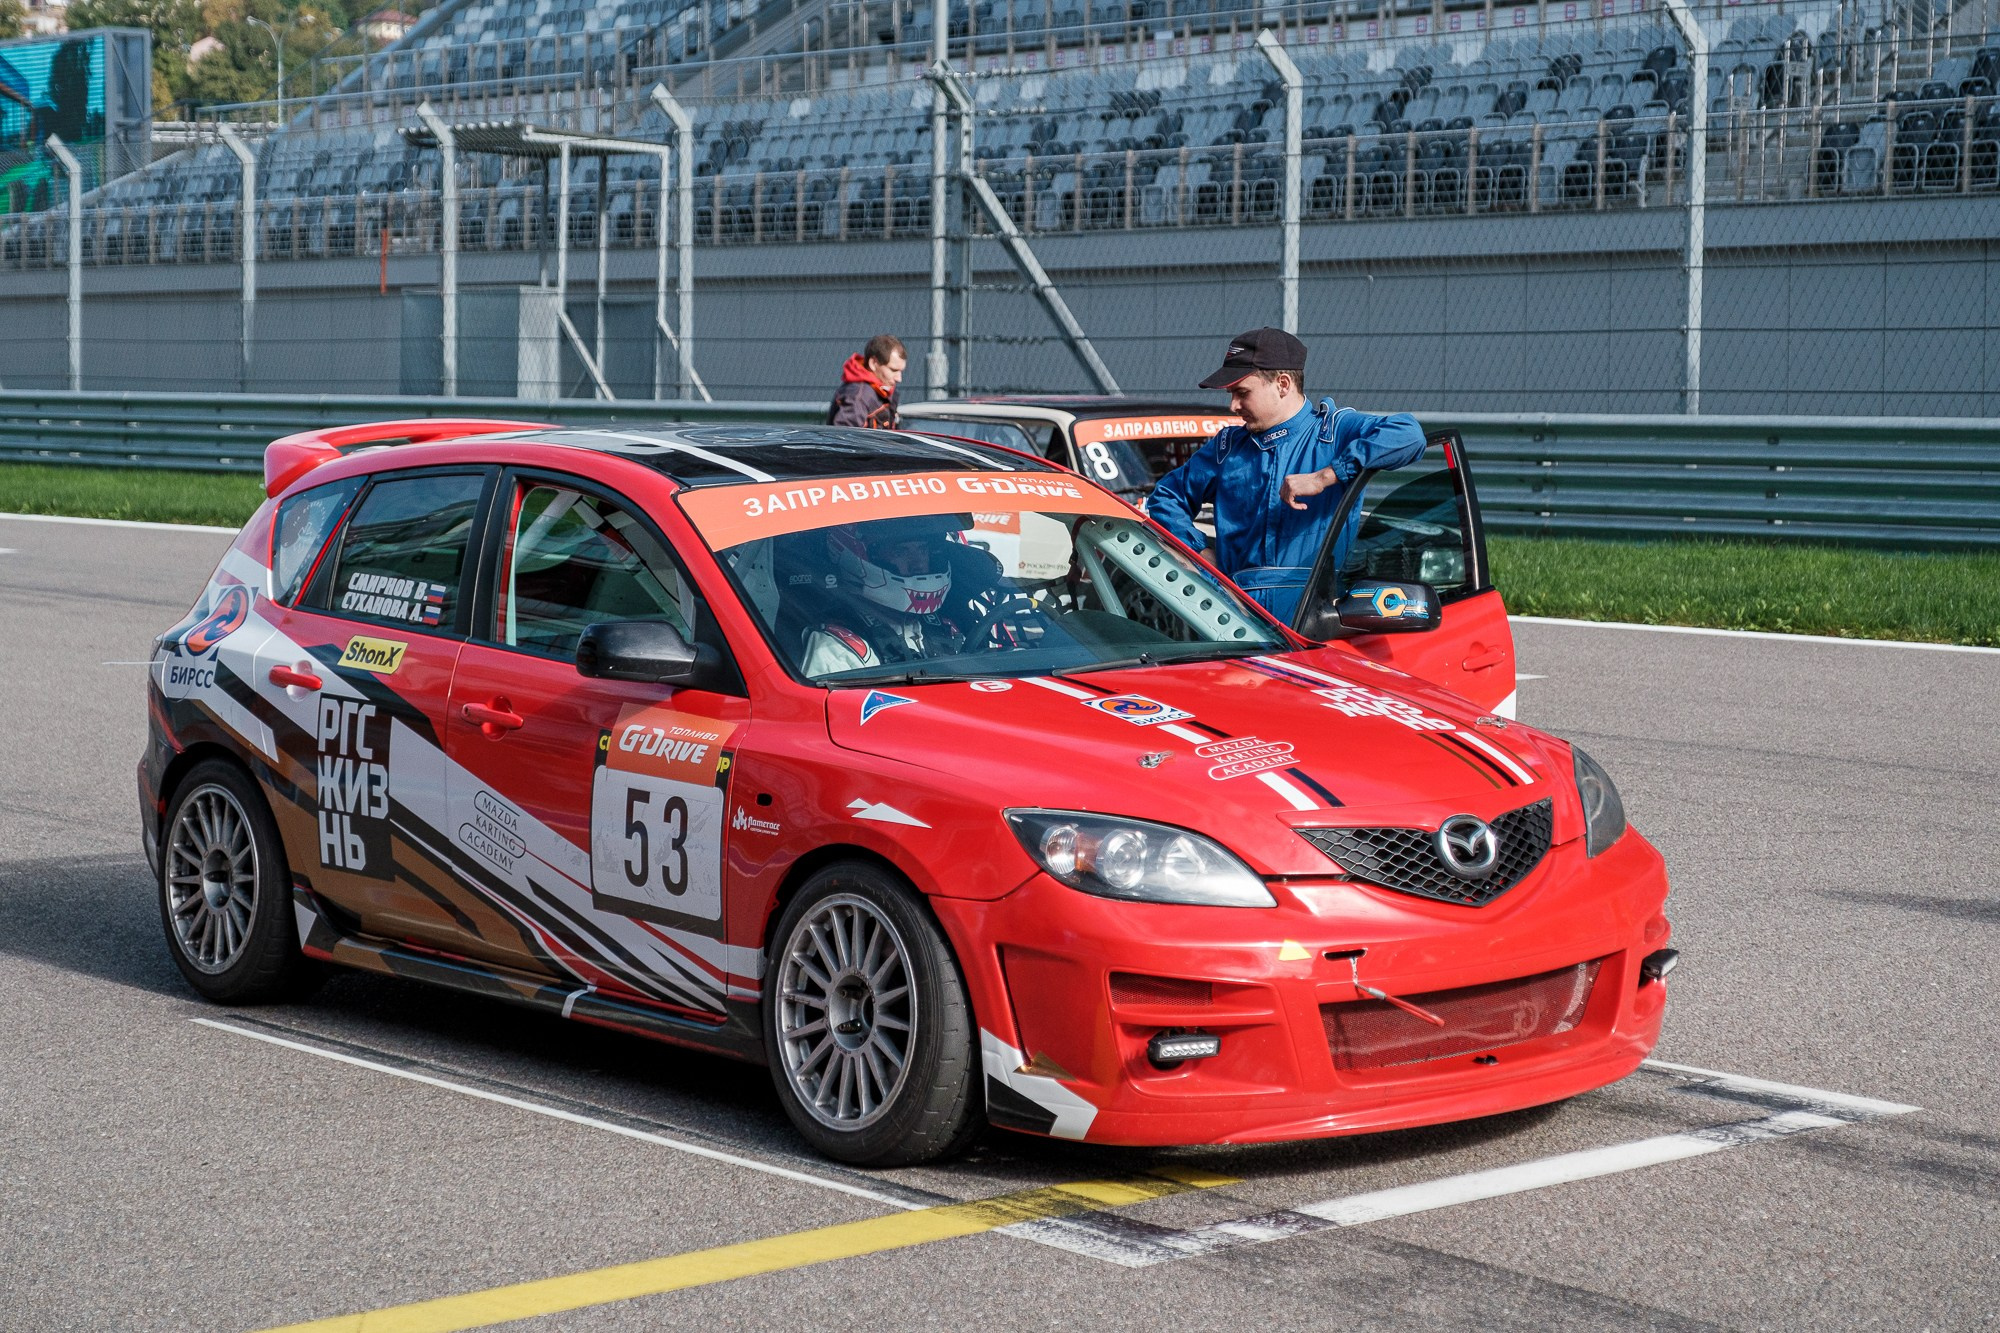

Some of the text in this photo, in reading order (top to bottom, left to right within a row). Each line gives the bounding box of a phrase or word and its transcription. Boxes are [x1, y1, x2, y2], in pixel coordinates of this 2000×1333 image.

[1103, 419, 1198, 438] ЗАПРАВЛЕНО
[1263, 428, 1288, 444] sparco
[1085, 441, 1119, 480] 8
[1010, 476, 1074, 488] ТОПЛИВО
[743, 477, 947, 517] ЗАПРАВЛЕНО
[348, 572, 428, 601] СМИРНОВ В.
[341, 591, 423, 622] СУХАНОВА А.
[345, 641, 402, 667] ShonX
[170, 665, 214, 689] БИРСС
[318, 698, 376, 759] РГС
[669, 726, 720, 741] ТОПЛИВО
[1133, 713, 1192, 725] БИРСС
[1207, 739, 1266, 753] MAZDA
[1214, 746, 1282, 764] KARTING
[1223, 754, 1295, 775] ACADEMY
[317, 755, 389, 820] ЖИЗ
[482, 798, 517, 831] MAZDA
[318, 810, 366, 871] НЬ
[475, 814, 516, 851] KARTING
[624, 787, 689, 896] 53
[466, 831, 514, 870] ACADEMY
